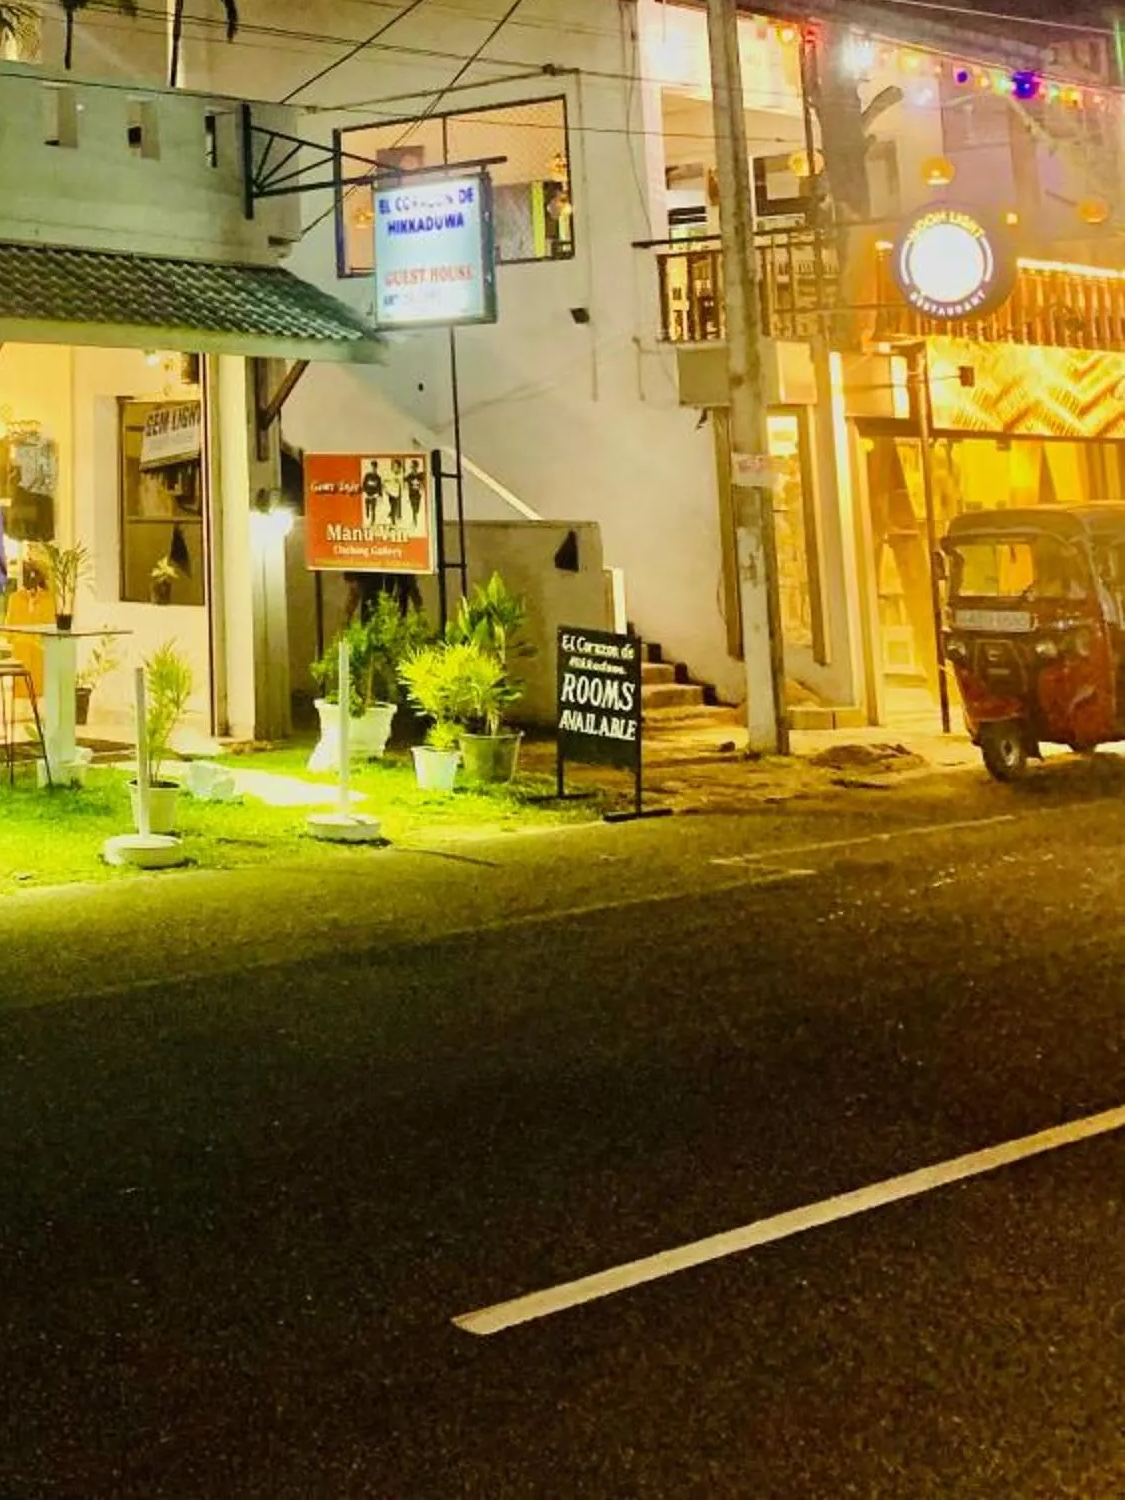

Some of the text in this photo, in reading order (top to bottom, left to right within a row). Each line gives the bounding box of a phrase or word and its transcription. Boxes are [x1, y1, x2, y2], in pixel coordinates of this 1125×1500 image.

[386, 211, 465, 236] HIKKADUWA
[560, 673, 636, 712] ROOMS
[558, 709, 637, 741] AVAILABLE
